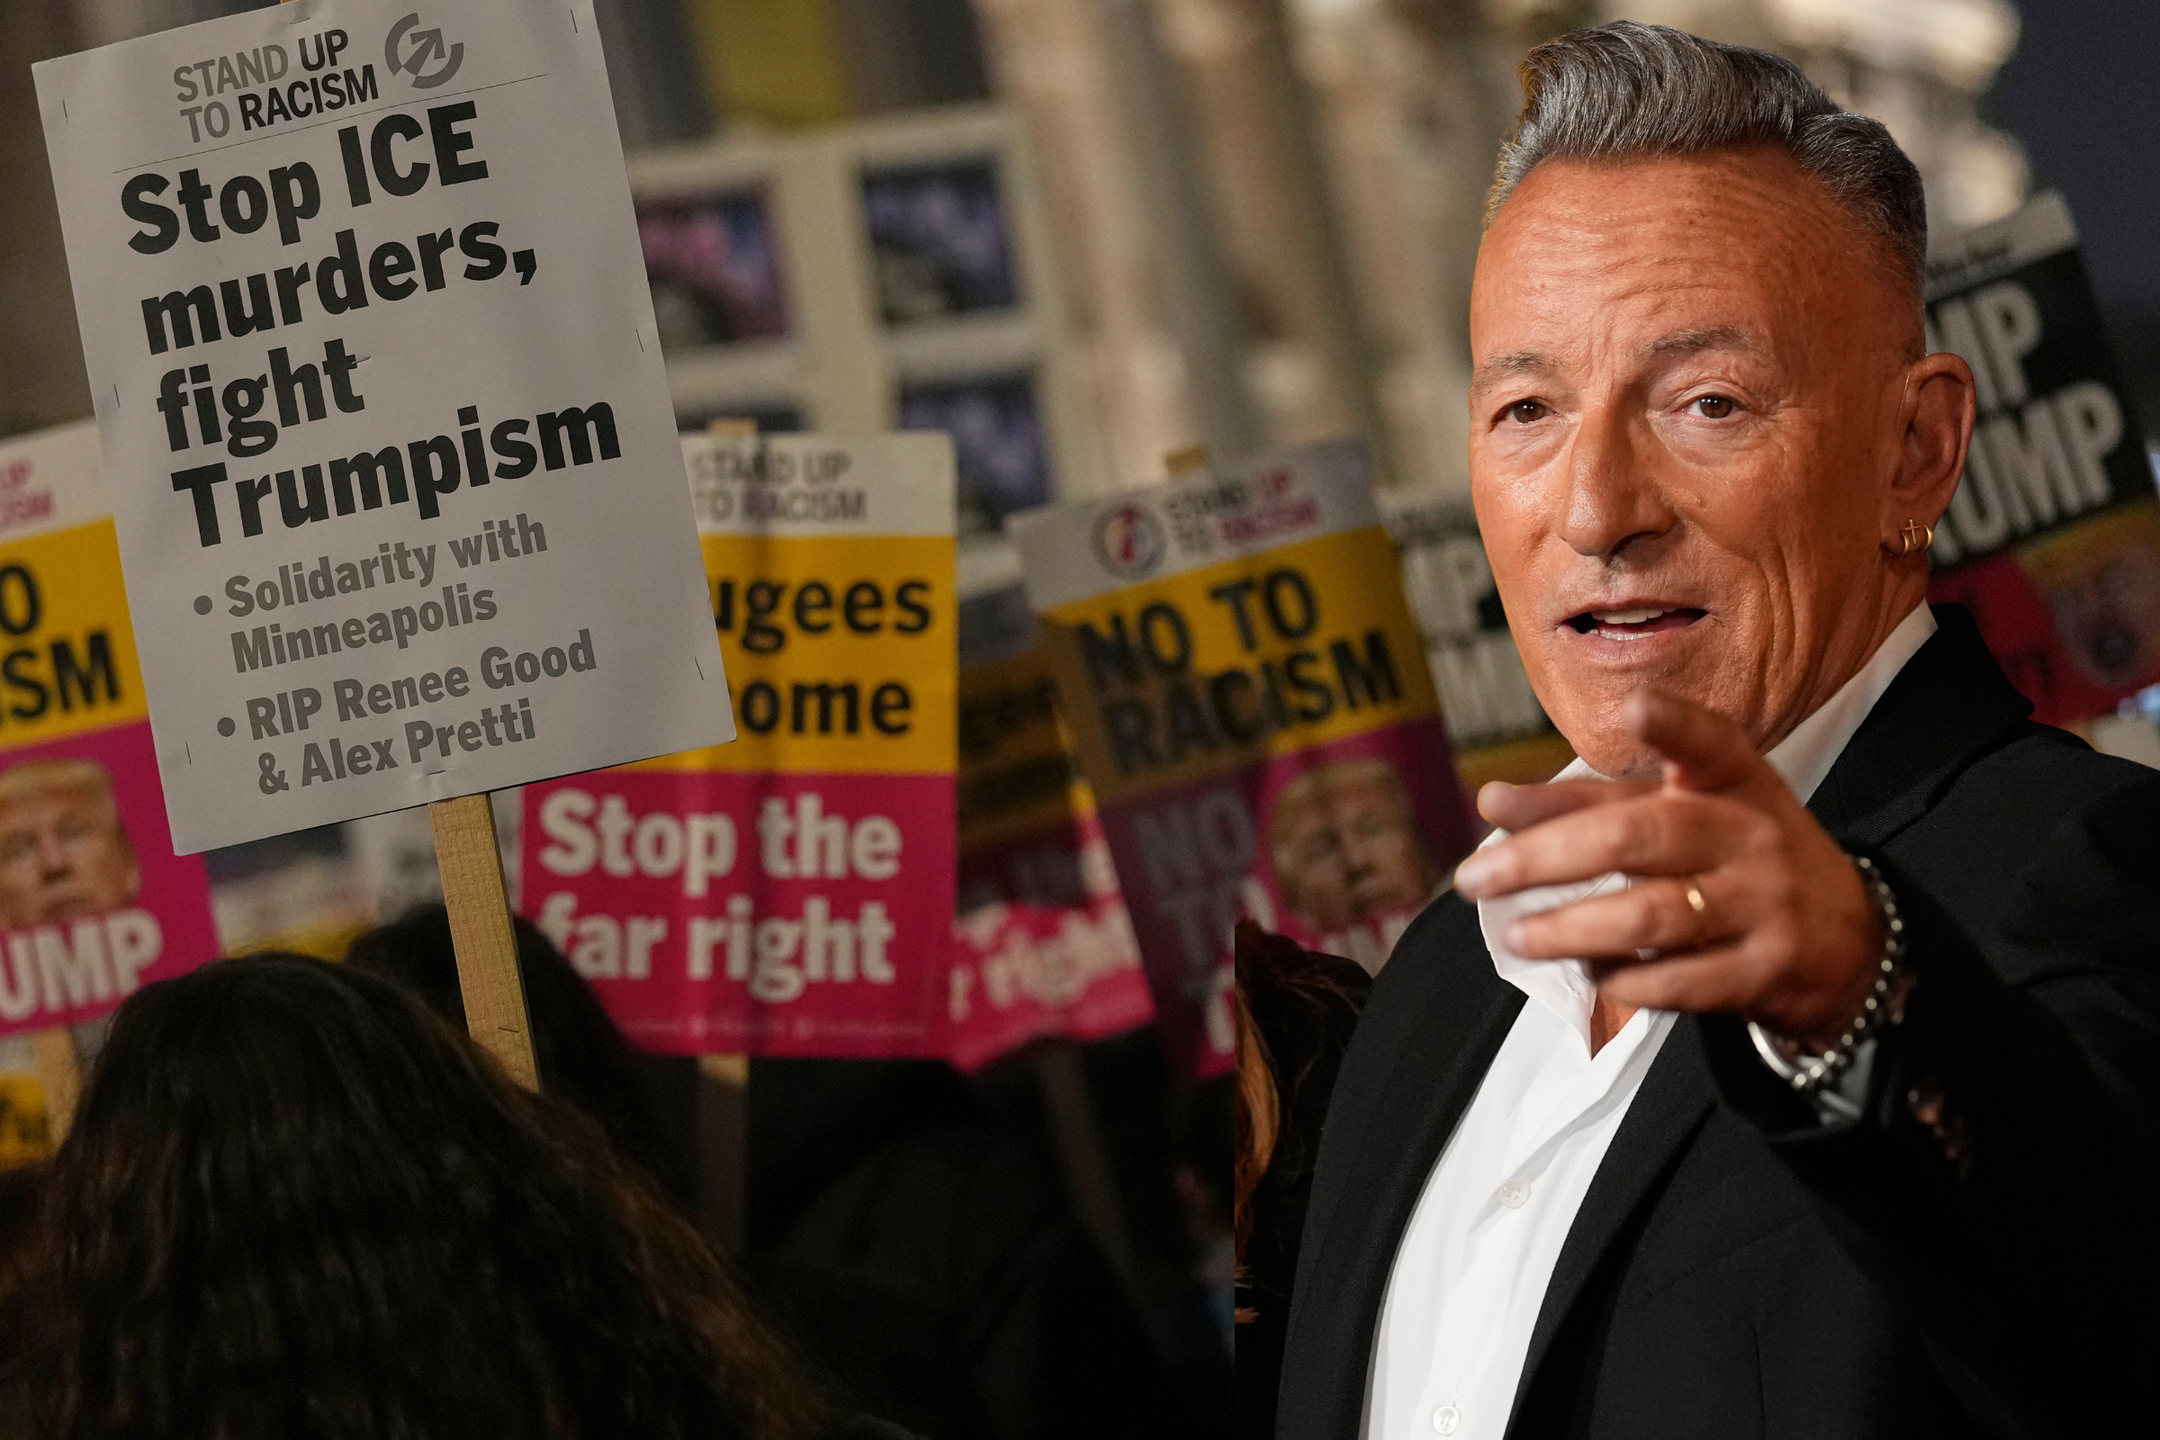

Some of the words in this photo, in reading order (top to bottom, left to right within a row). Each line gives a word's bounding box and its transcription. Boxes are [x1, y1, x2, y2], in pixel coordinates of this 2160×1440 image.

[174, 45, 288, 102] STAND
[299, 28, 349, 75] UP
[180, 101, 230, 143] TO
[238, 64, 379, 131] RACISM
[121, 162, 321, 255] Stop
[338, 100, 489, 207] ICE
[141, 221, 537, 355] murders,
[156, 338, 365, 457] fight
[171, 402, 621, 548] Trumpism
[691, 450, 797, 485] STAND
[803, 450, 851, 486] UP
[742, 487, 867, 523] RACISM
[1928, 381, 2122, 563] UMP
[225, 541, 436, 617] Solidarity
[448, 513, 547, 568] with
[231, 586, 497, 673] Minneapolis
[246, 688, 322, 740] RIP
[333, 667, 470, 722] Renee
[481, 628, 597, 689] Good
[1080, 602, 1192, 692] NO
[1210, 569, 1319, 651] TO
[258, 752, 289, 795] &
[302, 738, 398, 787] Alex
[404, 698, 535, 763] Pretti
[1105, 629, 1400, 775] RACISM
[539, 789, 738, 898] Stop
[758, 793, 902, 880] the
[540, 892, 668, 980] far
[687, 895, 895, 1002] right
